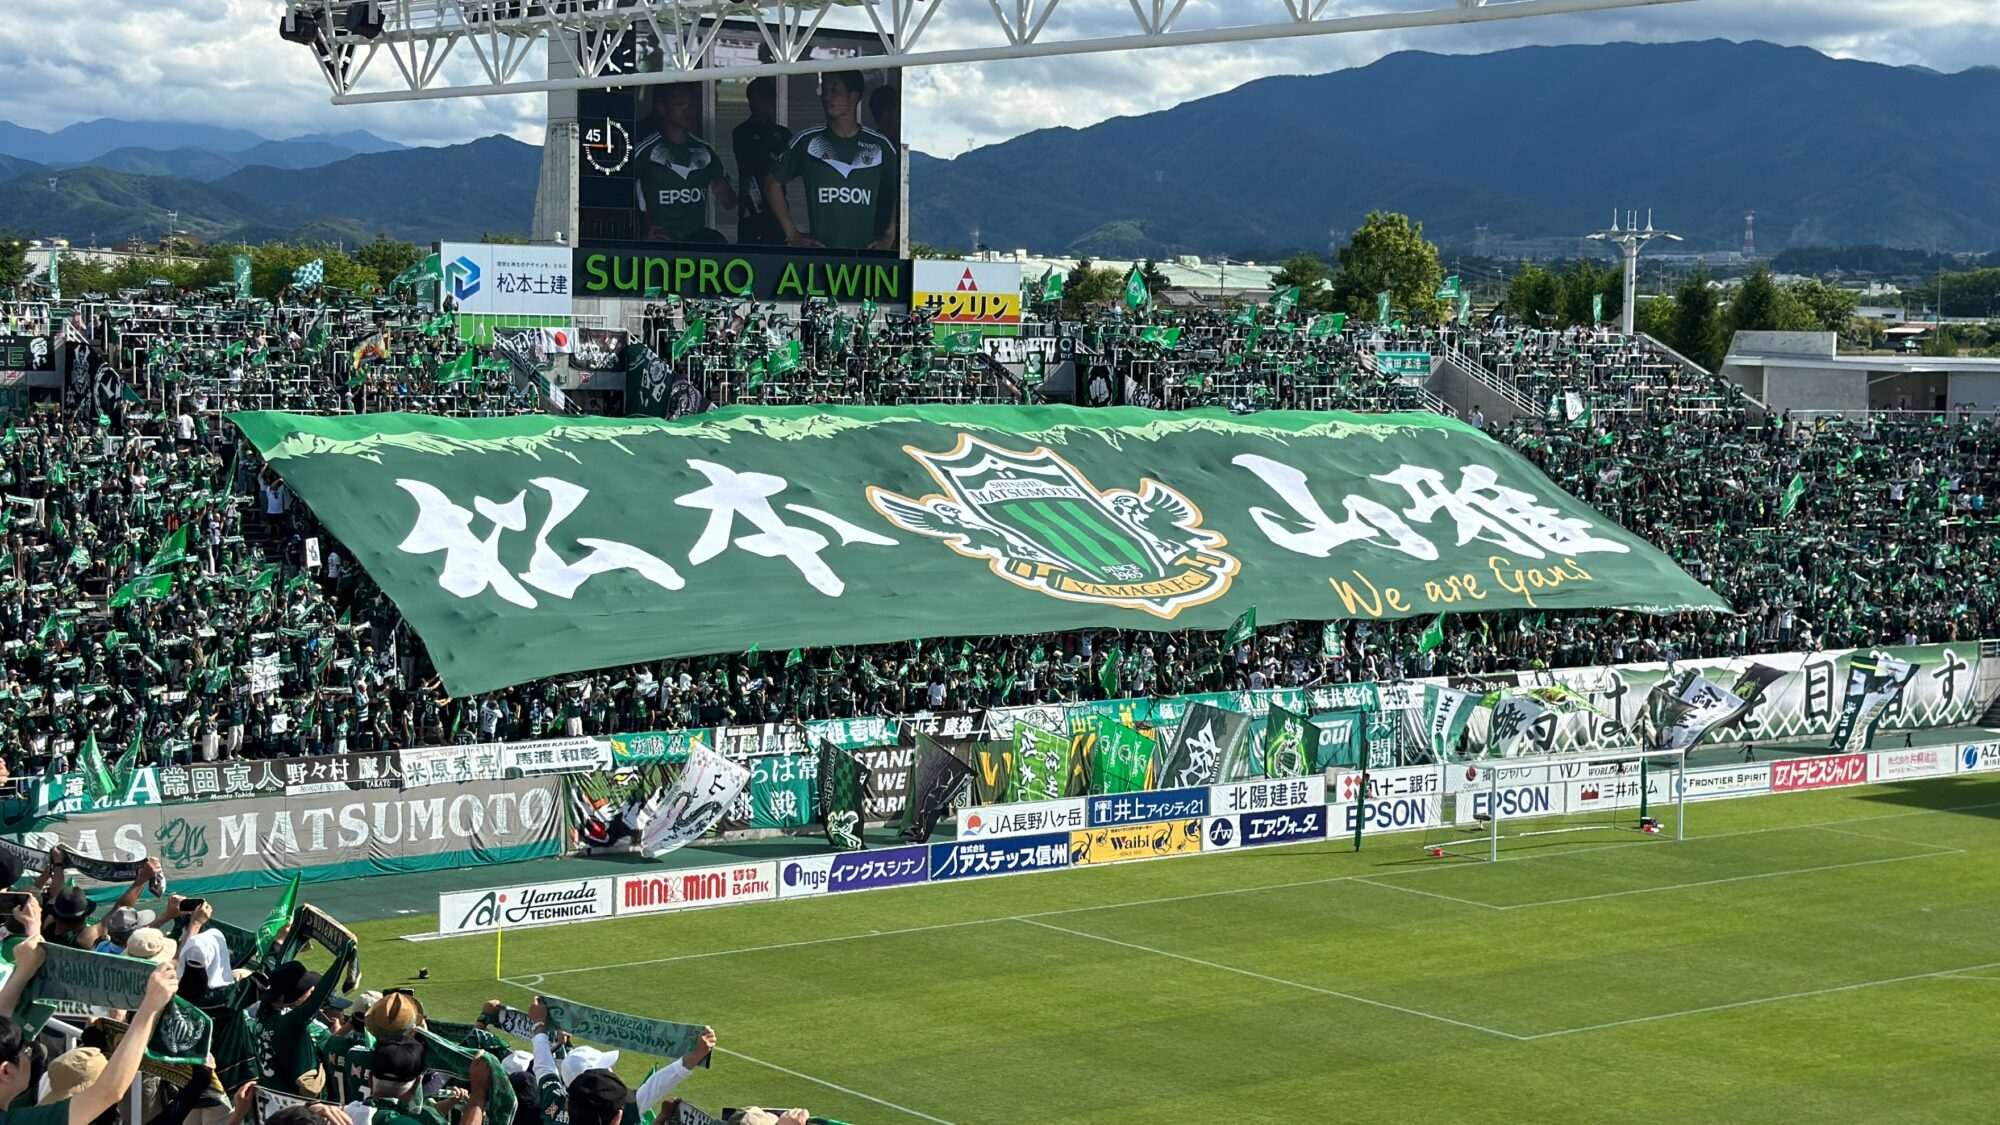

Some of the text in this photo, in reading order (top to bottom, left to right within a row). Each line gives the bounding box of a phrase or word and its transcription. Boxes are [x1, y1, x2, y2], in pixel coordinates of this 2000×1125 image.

[586, 129, 600, 142] 45
[659, 188, 706, 204] EPSON
[818, 187, 871, 205] EPSON
[497, 272, 568, 294] 松本土建
[777, 263, 899, 299] ALWIN
[925, 294, 1008, 321] サンリン
[968, 487, 1081, 504] MATSUMOTO
[990, 480, 1042, 489] SHINSHU
[395, 452, 1631, 609] 松本 山雅
[1100, 563, 1141, 574] SINCE
[1112, 569, 1144, 581] 1965
[1073, 578, 1173, 598] YAMAGA
[1328, 570, 1411, 618] We
[1425, 572, 1487, 606] are
[1931, 651, 1967, 715] す
[1319, 719, 1353, 746] oul
[506, 740, 589, 751] MAWATARI KAZUAKI
[160, 761, 285, 797] 常田克人
[286, 758, 350, 785] 野々村
[877, 772, 907, 791] WE
[1588, 765, 1617, 777] WORLD
[1689, 776, 1734, 788] FRONTIER
[1736, 772, 1768, 783] SPIRIT
[1788, 757, 1865, 787] トラビスジャパン
[1229, 781, 1309, 811] 北陽建設
[1473, 786, 1549, 817] EPSON
[1603, 780, 1658, 799] 三井ホム
[217, 786, 553, 862] MATSUMOTO
[1346, 798, 1426, 832] EPSON
[1110, 834, 1150, 850] Waibi
[831, 856, 927, 883] イングスシナノ
[959, 844, 1068, 875] アステップ信州
[625, 871, 727, 907] mini mini
[732, 880, 769, 896] BANK
[506, 881, 597, 923] Yamada
[530, 904, 597, 921] TECHNICAL
